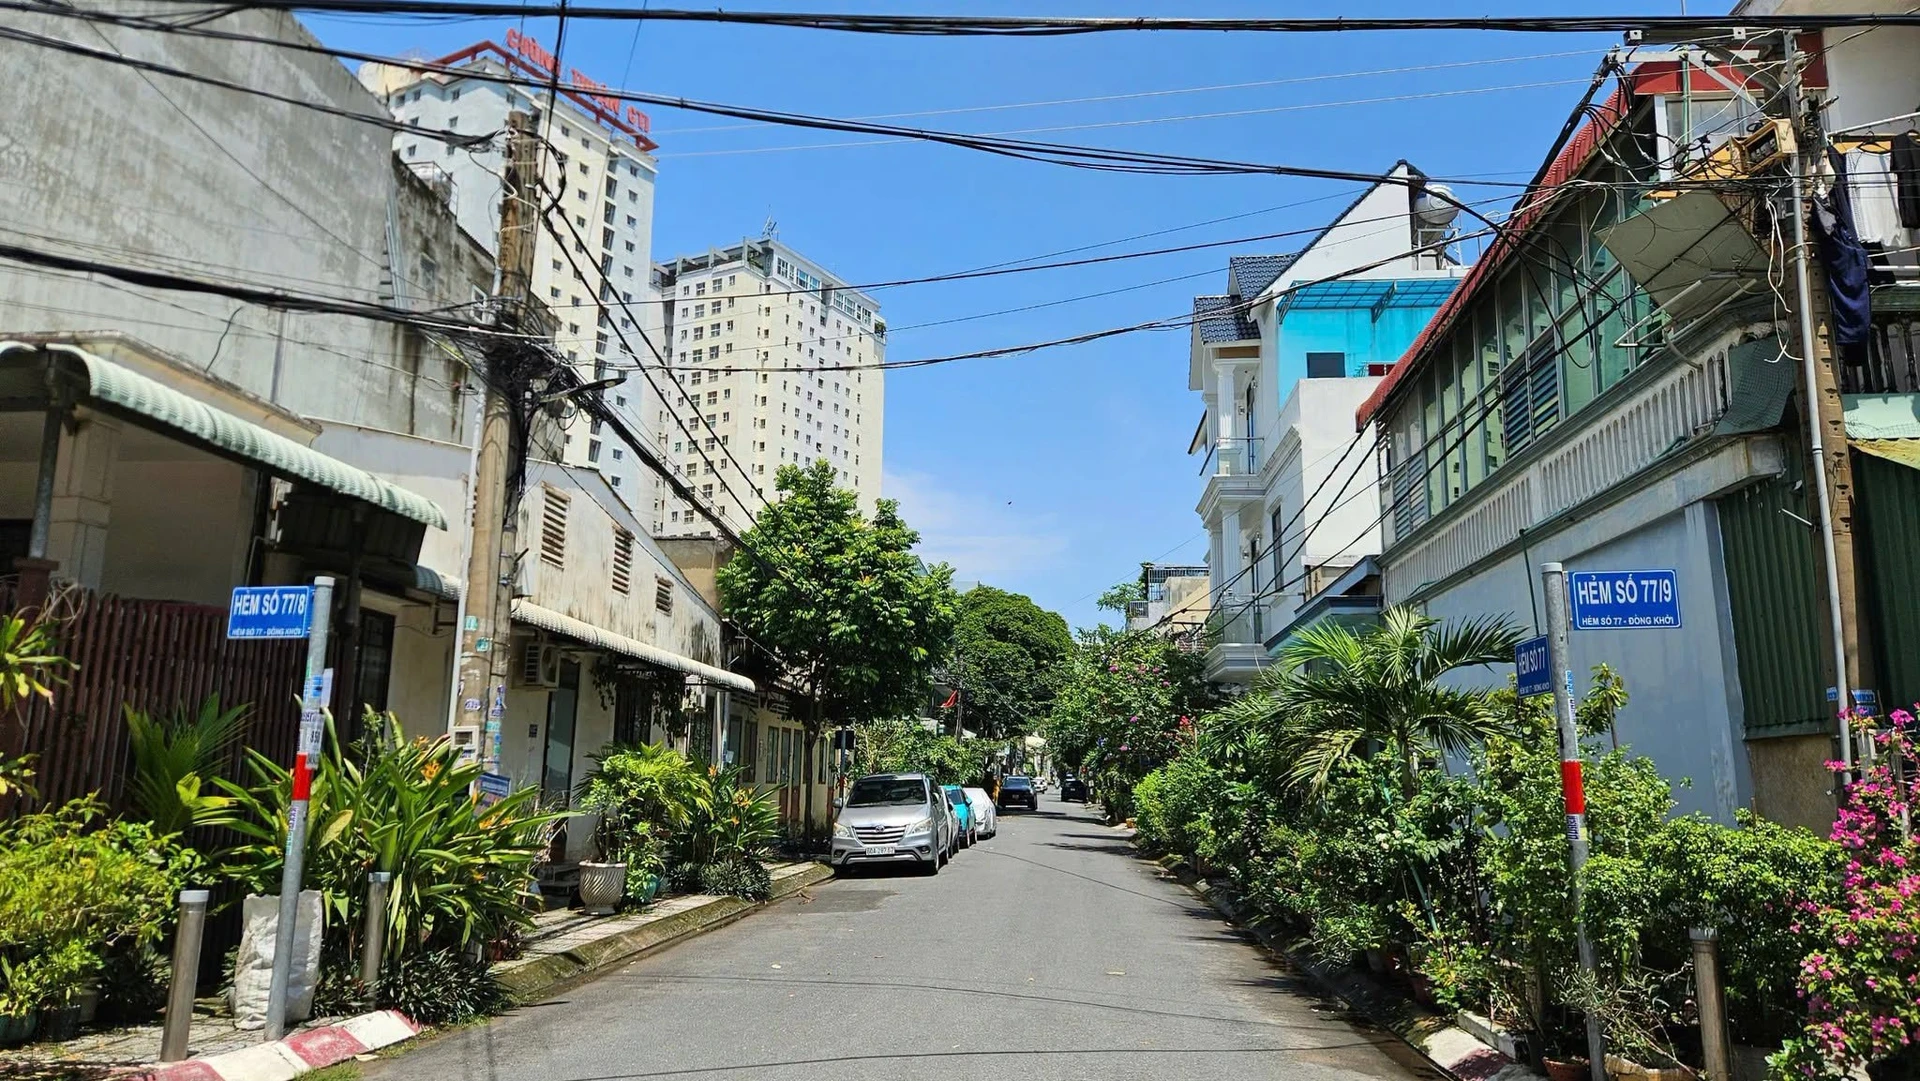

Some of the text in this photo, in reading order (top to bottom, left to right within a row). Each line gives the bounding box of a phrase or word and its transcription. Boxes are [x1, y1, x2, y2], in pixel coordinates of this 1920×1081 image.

[627, 105, 651, 133] CTI
[261, 589, 279, 615] SỐ
[281, 594, 306, 615] 77/8
[1577, 573, 1672, 605] HẺM SỐ 77/9
[1613, 617, 1622, 625] 77
